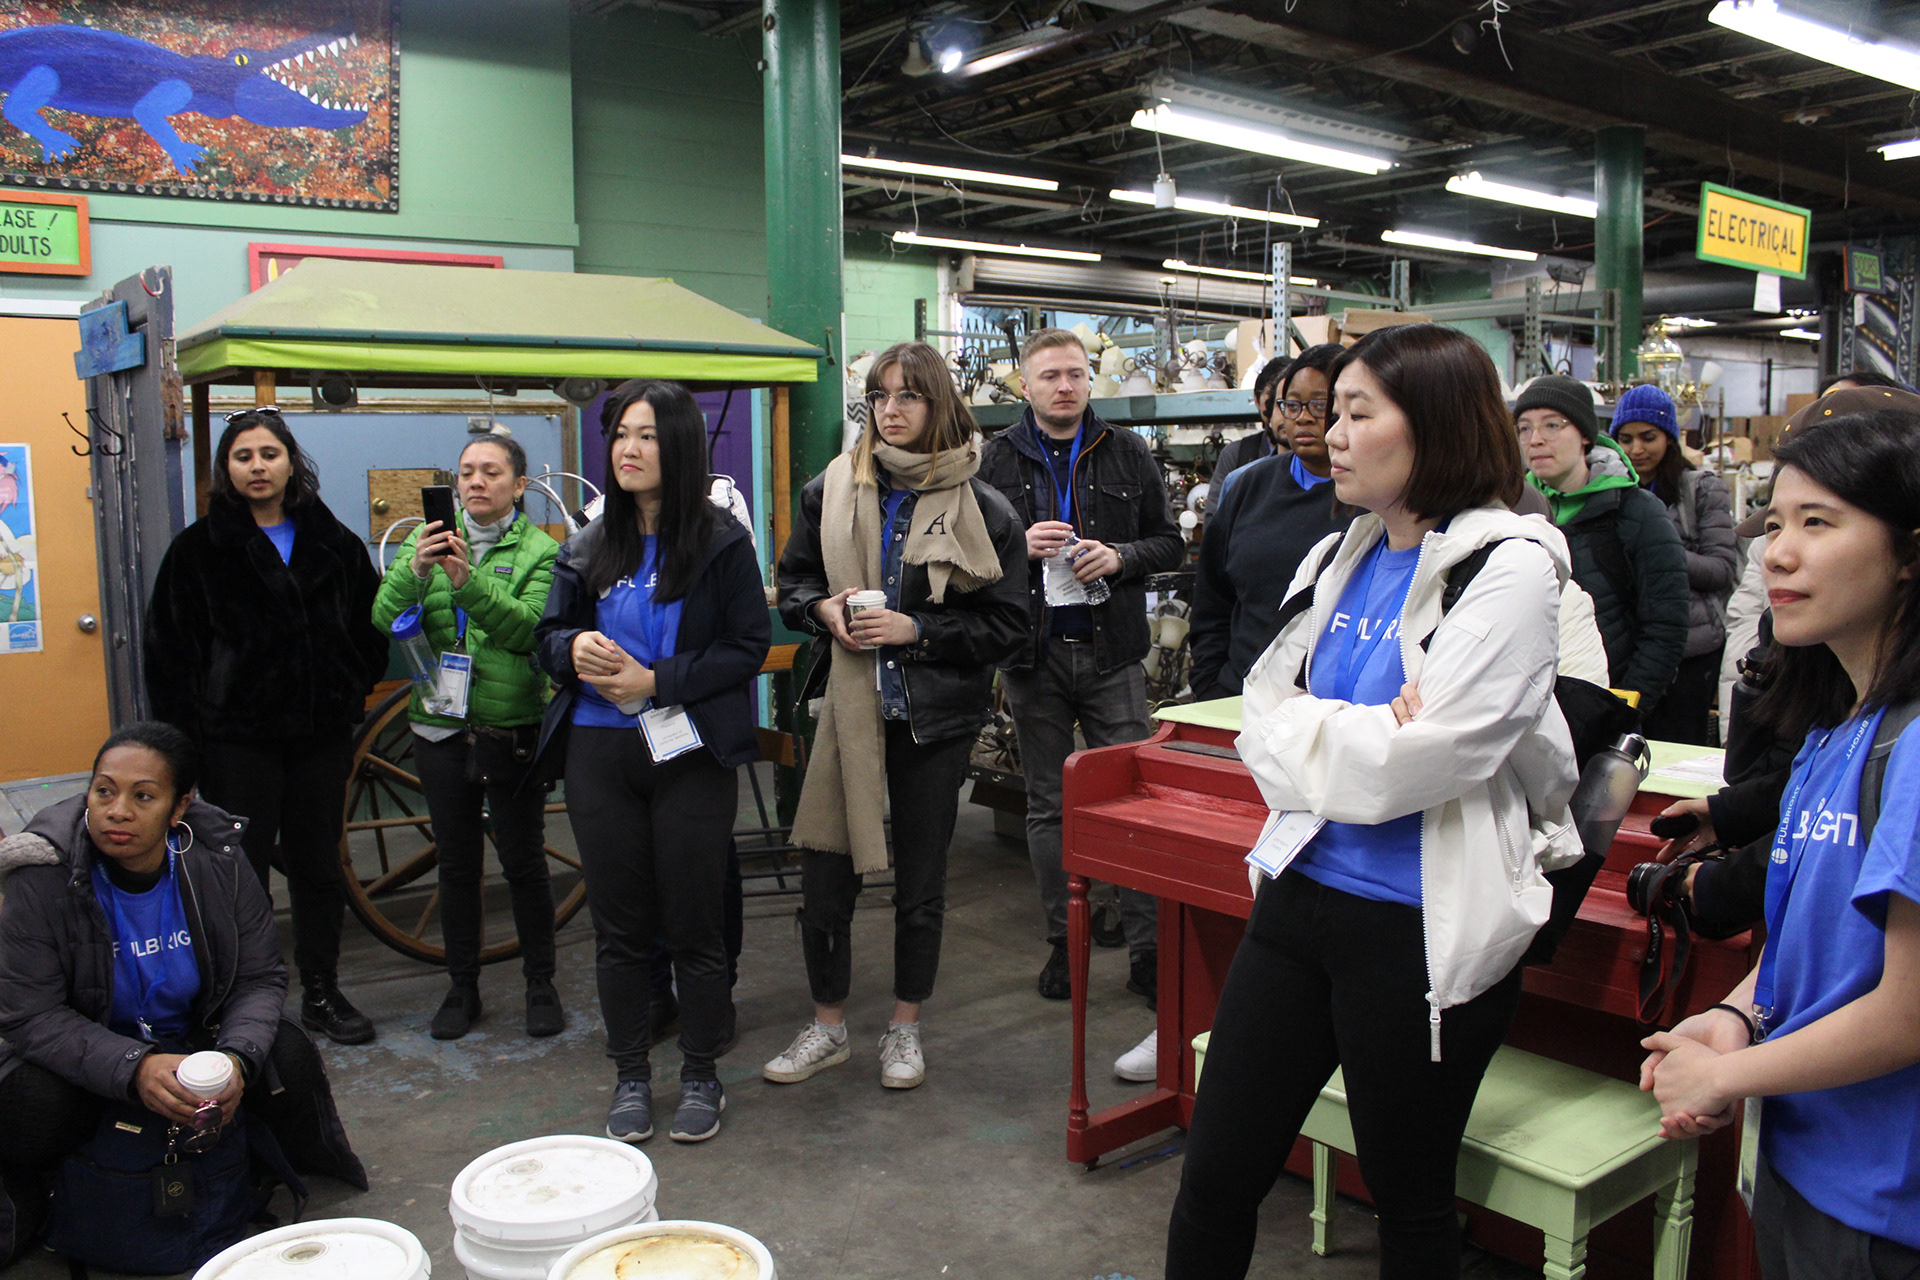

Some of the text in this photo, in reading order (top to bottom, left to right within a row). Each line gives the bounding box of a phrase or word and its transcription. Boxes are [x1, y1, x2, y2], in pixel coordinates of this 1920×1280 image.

[0, 209, 37, 228] ASE
[1707, 208, 1797, 256] ELECTRICAL
[923, 510, 948, 535] A
[1777, 785, 1801, 845] FULBRIGHT
